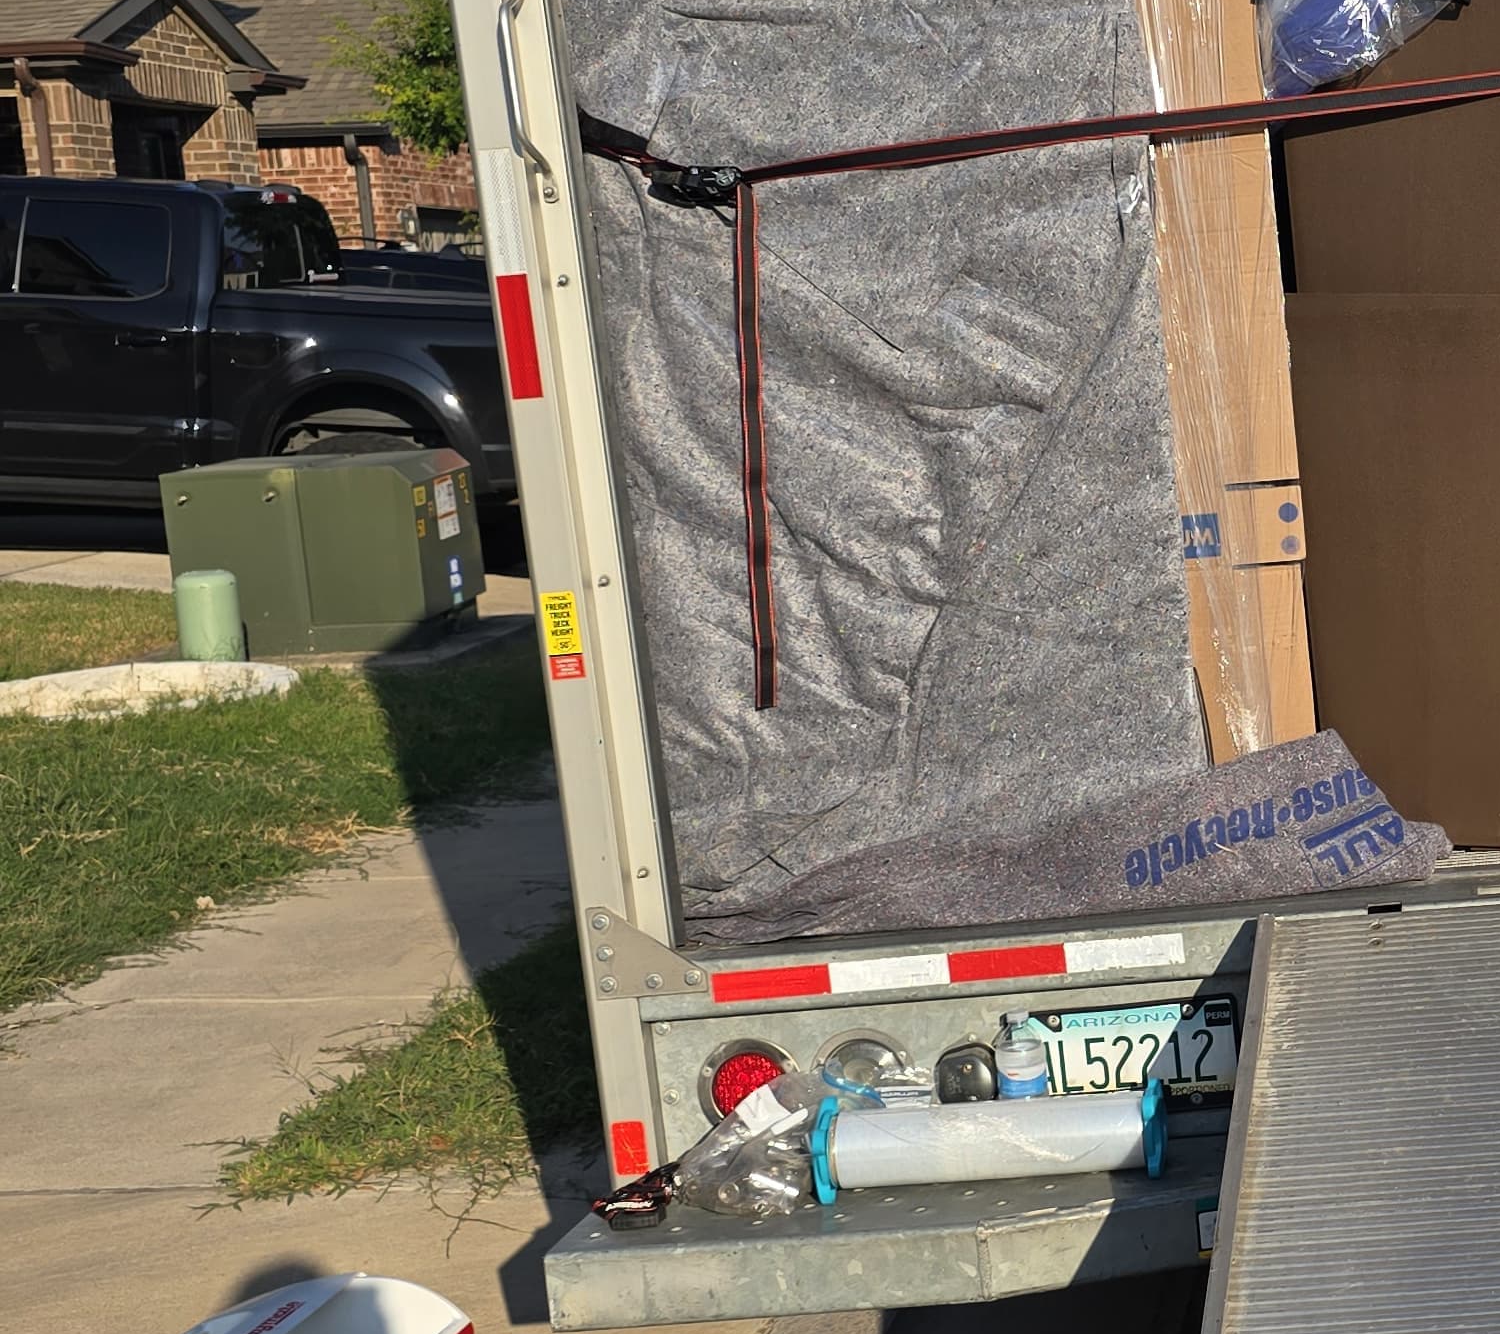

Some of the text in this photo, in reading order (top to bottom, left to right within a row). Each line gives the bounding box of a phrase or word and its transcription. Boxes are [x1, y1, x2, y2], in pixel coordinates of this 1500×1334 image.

[545, 602, 572, 611] FREIGHT
[549, 611, 571, 619] TRUCK
[553, 620, 570, 628] DECK
[551, 628, 574, 637] HEIGHT
[1066, 1010, 1231, 1029] ARIZONA PERM
